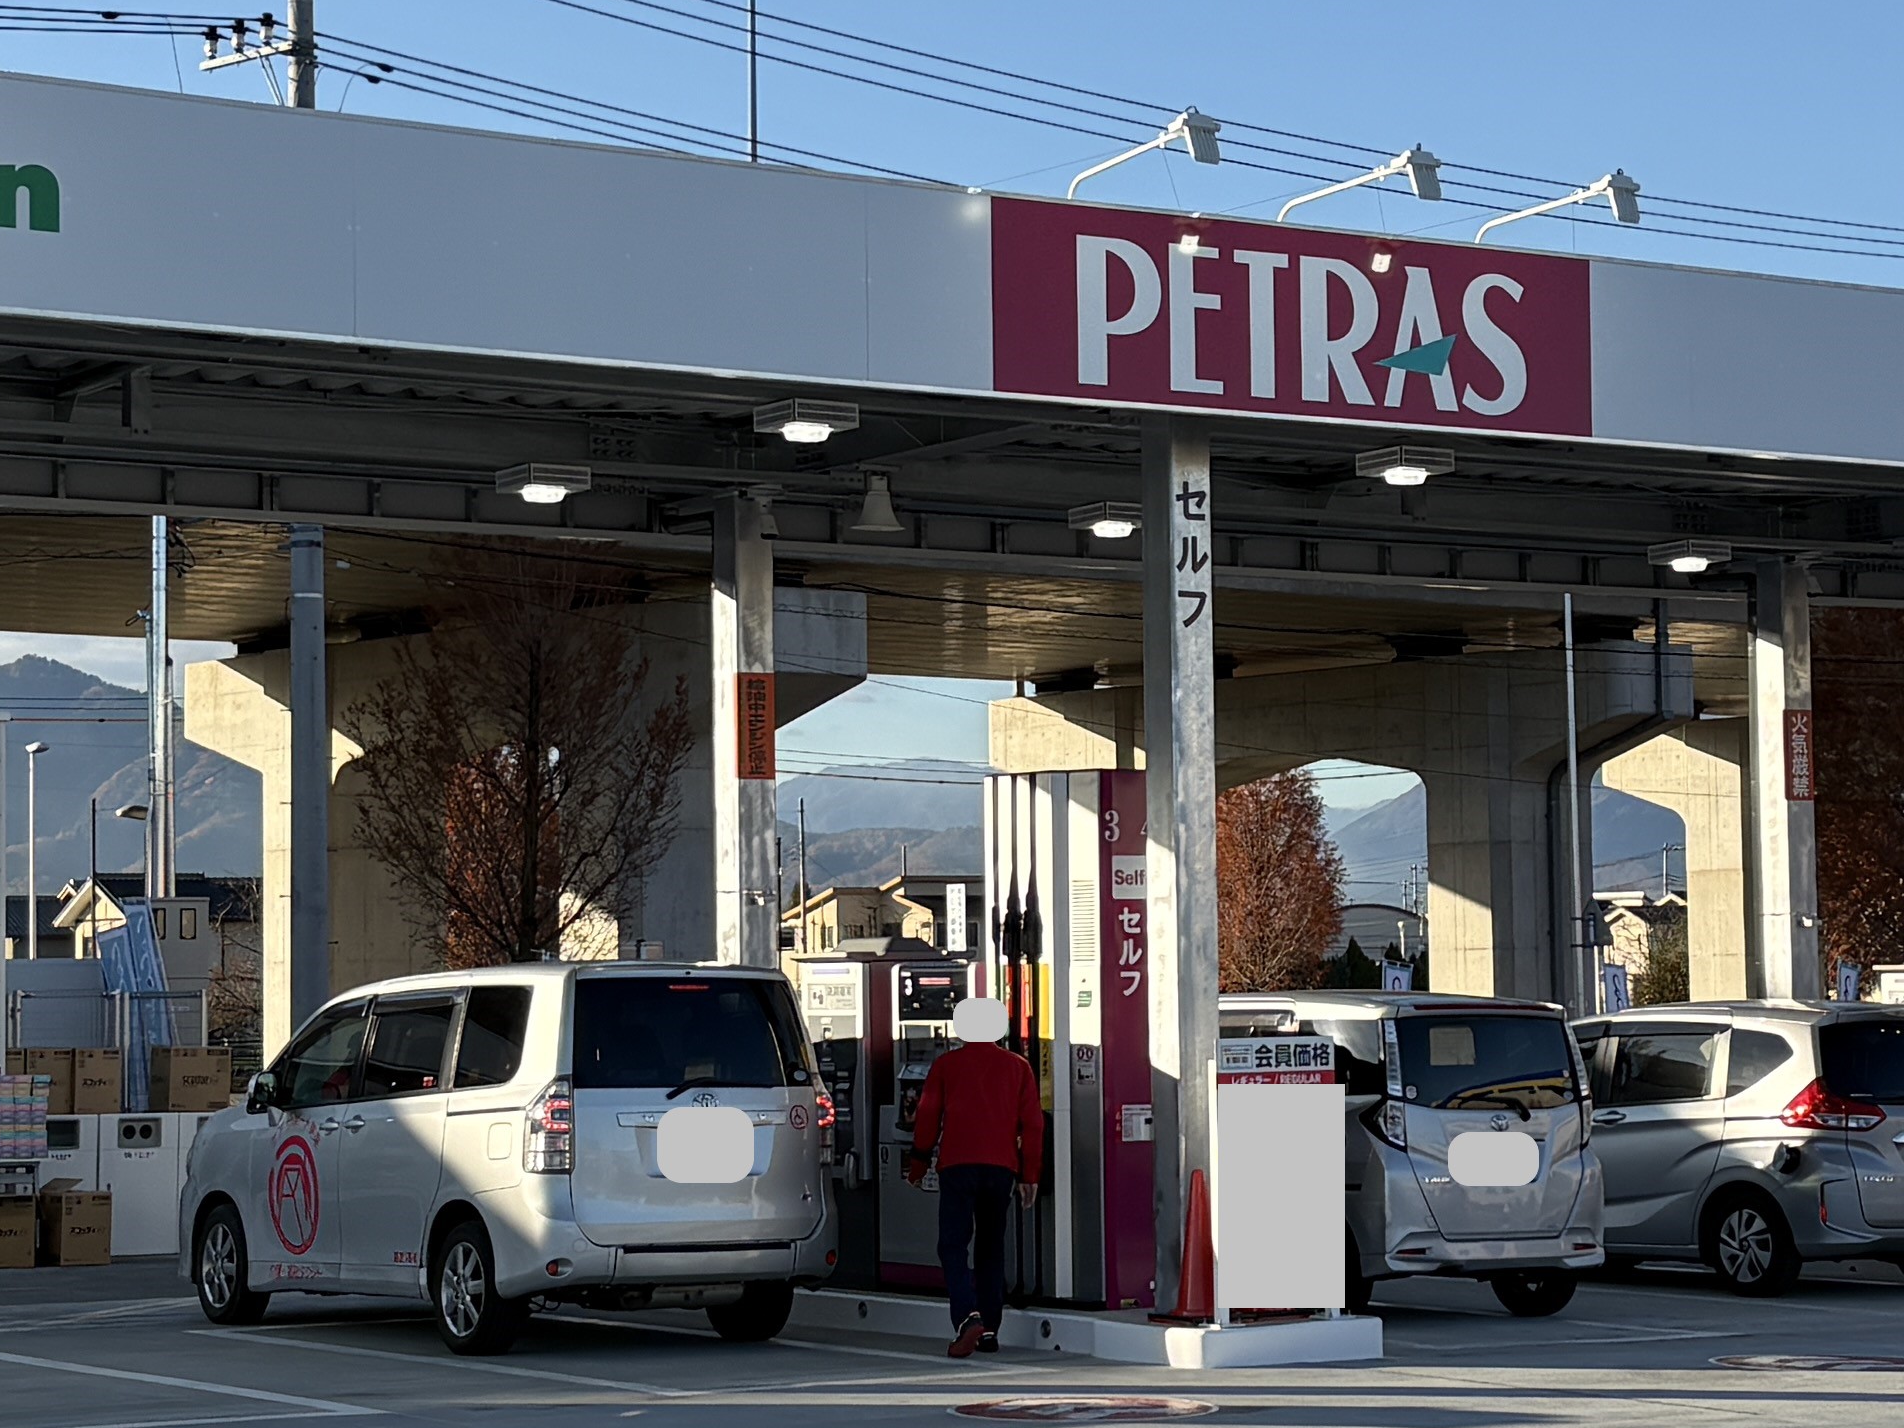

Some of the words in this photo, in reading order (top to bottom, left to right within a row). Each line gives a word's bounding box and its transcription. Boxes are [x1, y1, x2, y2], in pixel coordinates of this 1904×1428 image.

[1076, 234, 1527, 416] PETRAS
[1175, 480, 1209, 629] セルフ
[1104, 810, 1121, 842] 3
[1114, 869, 1146, 886] Self
[1118, 906, 1143, 997] セルフ
[1254, 1043, 1330, 1068] 会員価格
